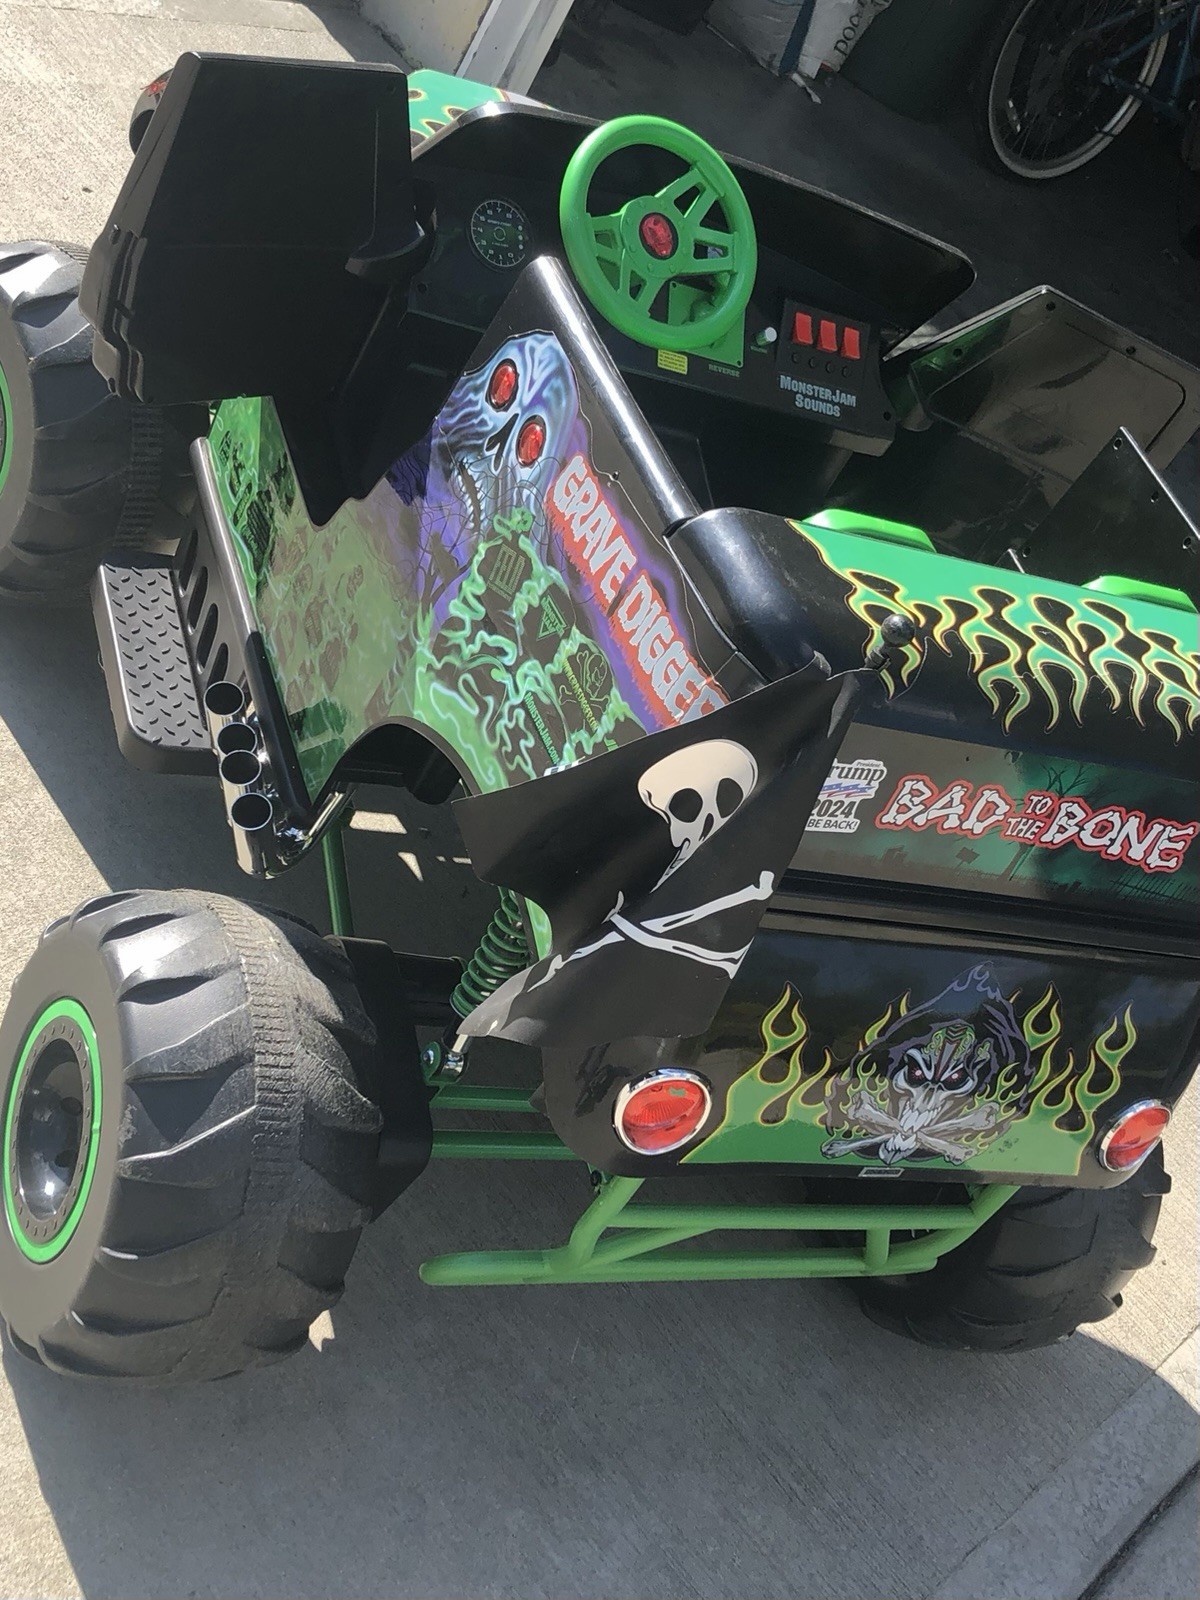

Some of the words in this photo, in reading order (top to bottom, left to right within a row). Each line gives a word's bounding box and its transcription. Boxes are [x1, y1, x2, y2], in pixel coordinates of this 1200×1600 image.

[795, 393, 841, 417] SOUNDS
[553, 455, 637, 604] GRAVE
[828, 765, 885, 787] rump
[881, 780, 1011, 834] BAD
[1027, 794, 1052, 816] TO
[807, 818, 823, 829] BE
[823, 820, 858, 830] BACK!
[1004, 816, 1046, 840] THE
[1040, 801, 1195, 869] BONE
